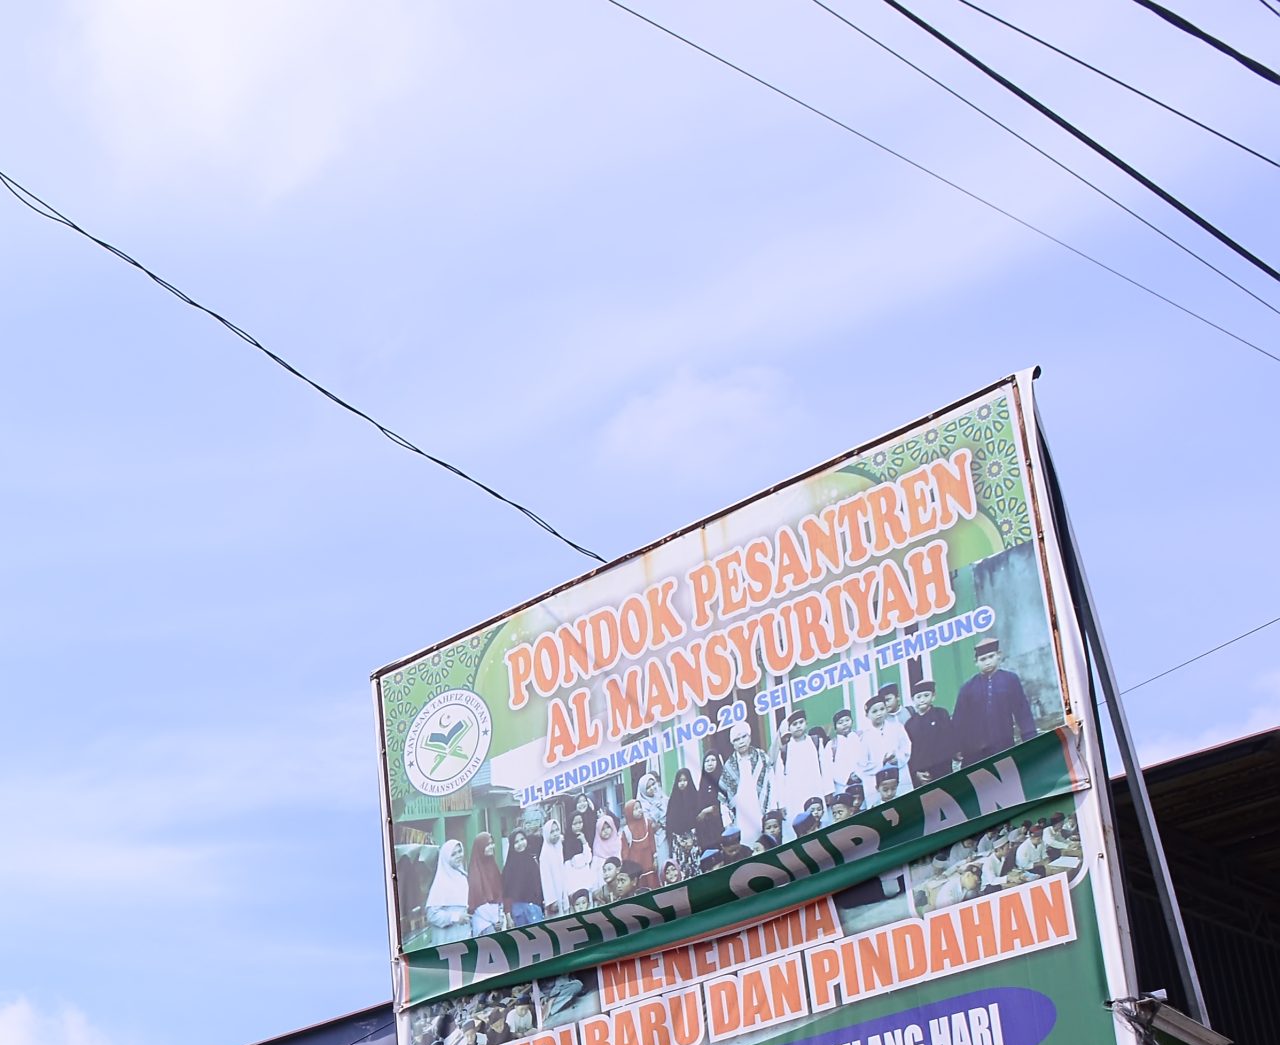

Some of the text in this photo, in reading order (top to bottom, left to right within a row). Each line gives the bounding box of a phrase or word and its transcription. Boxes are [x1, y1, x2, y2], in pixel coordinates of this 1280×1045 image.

[505, 450, 976, 707] PONDOK PESANTREN
[545, 542, 954, 765] AL MANSYURIYAH
[406, 711, 430, 757] YAYASAN
[431, 693, 464, 710] TAHFIZ
[543, 738, 658, 796] PENDIDIKAN
[662, 731, 671, 749] 1
[676, 717, 715, 744] NO.
[719, 702, 745, 727] 20
[756, 686, 788, 713] SEI
[793, 653, 870, 699] ROTAN
[877, 608, 993, 666] TEMBUNG
[600, 899, 837, 1005] MENERIMA
[709, 958, 804, 1037] DAN
[808, 879, 1071, 1008] PINDAHAN
